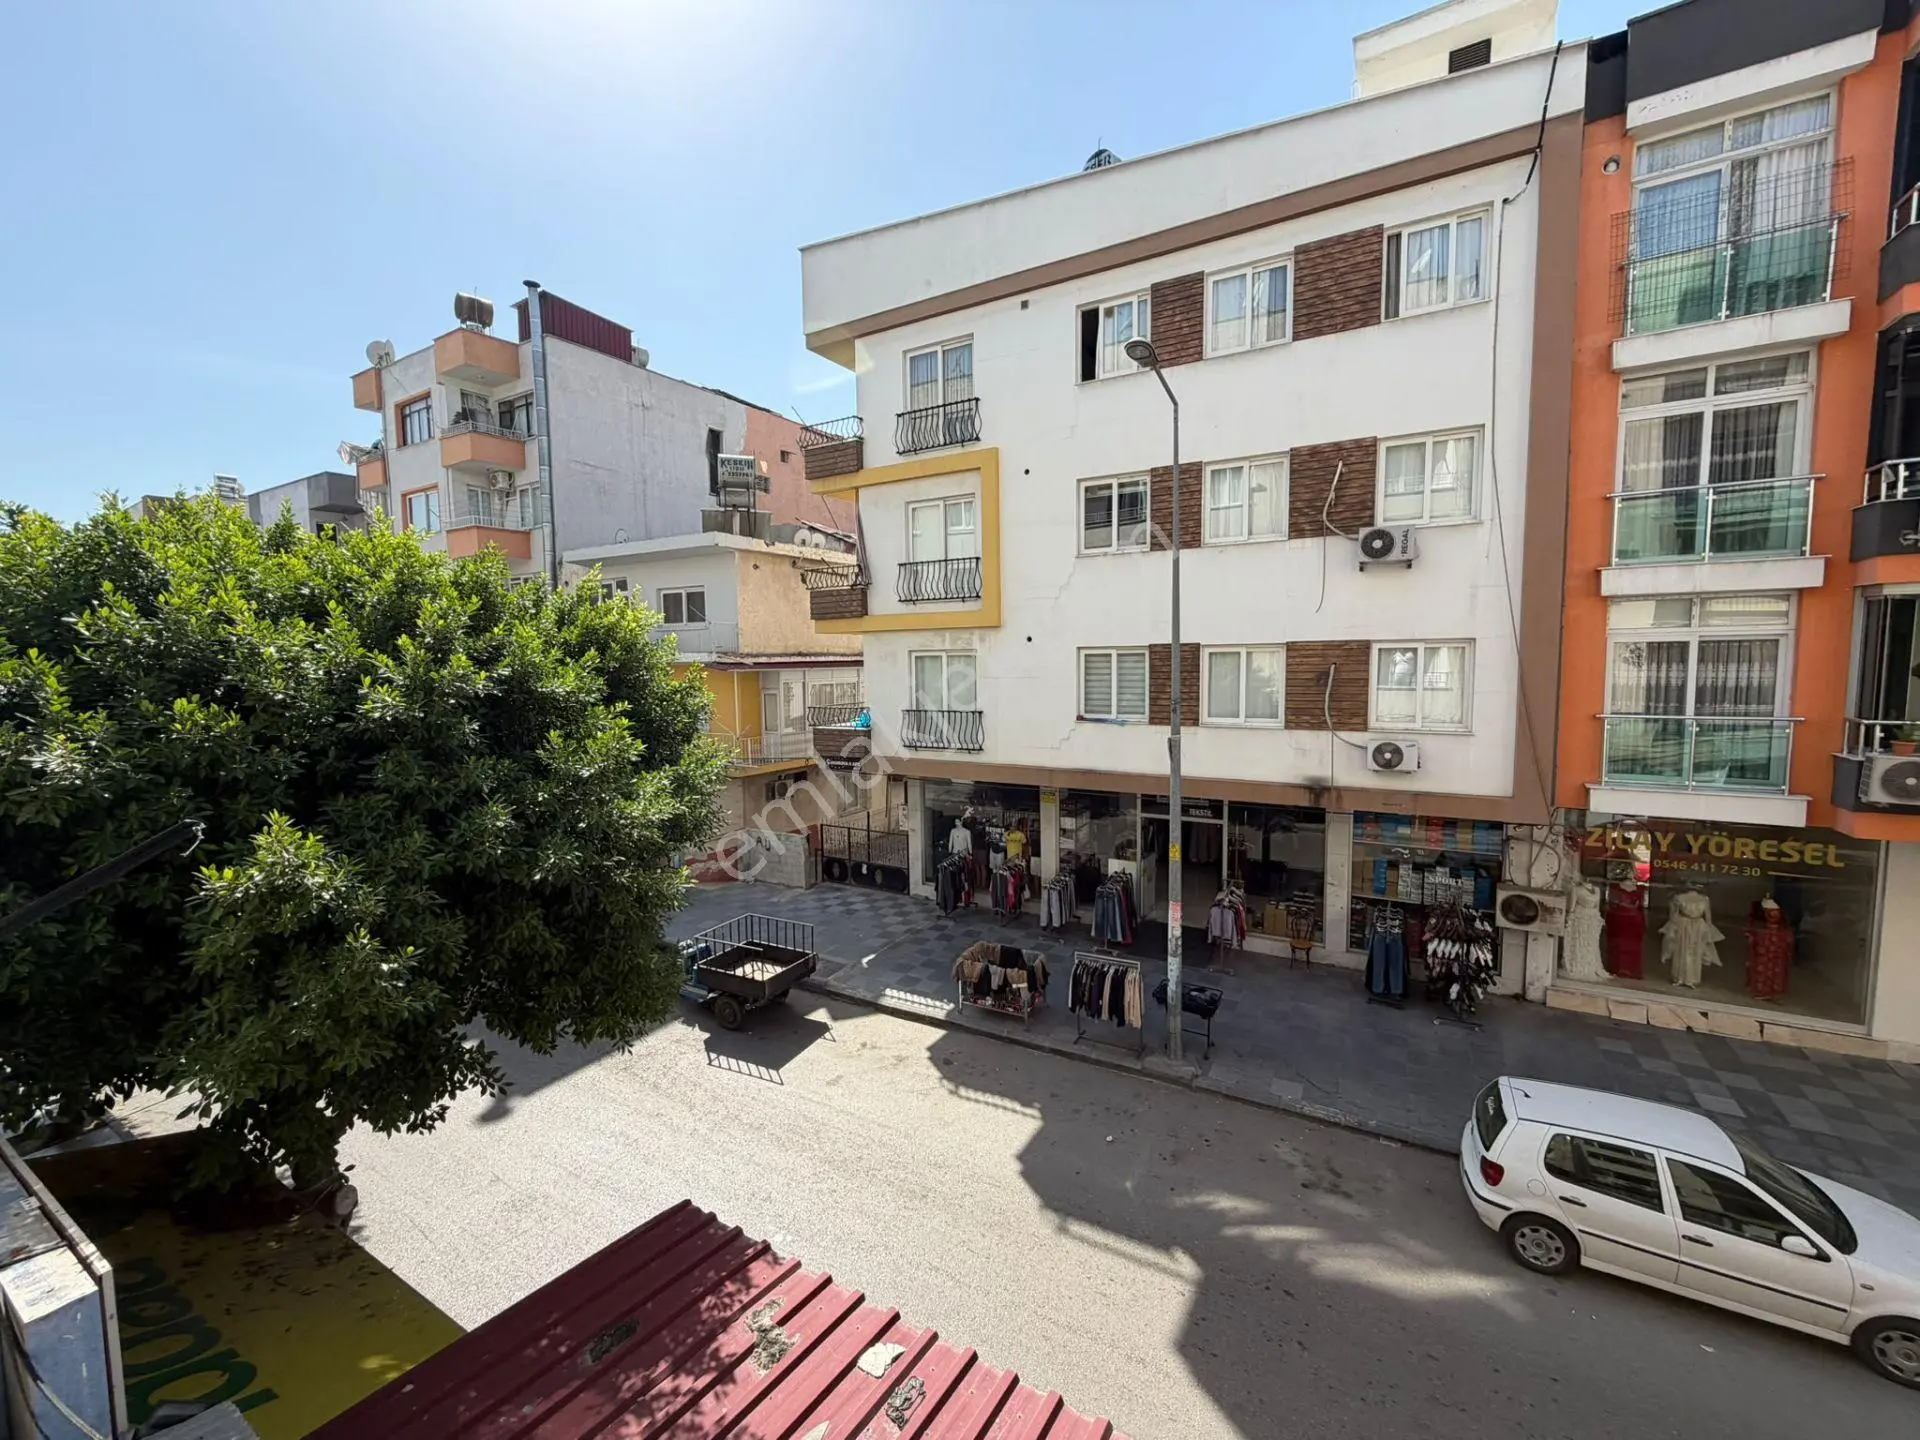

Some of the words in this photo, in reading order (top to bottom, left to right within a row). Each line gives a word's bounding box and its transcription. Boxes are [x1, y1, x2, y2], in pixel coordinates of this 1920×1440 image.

[1401, 528, 1409, 555] REGAL
[1685, 831, 1845, 868] YÖRESEL
[1654, 860, 1686, 870] 0546
[1691, 863, 1715, 872] 411
[1721, 864, 1738, 875] 72
[1742, 867, 1760, 876] 30
[1428, 875, 1464, 886] SPORT
